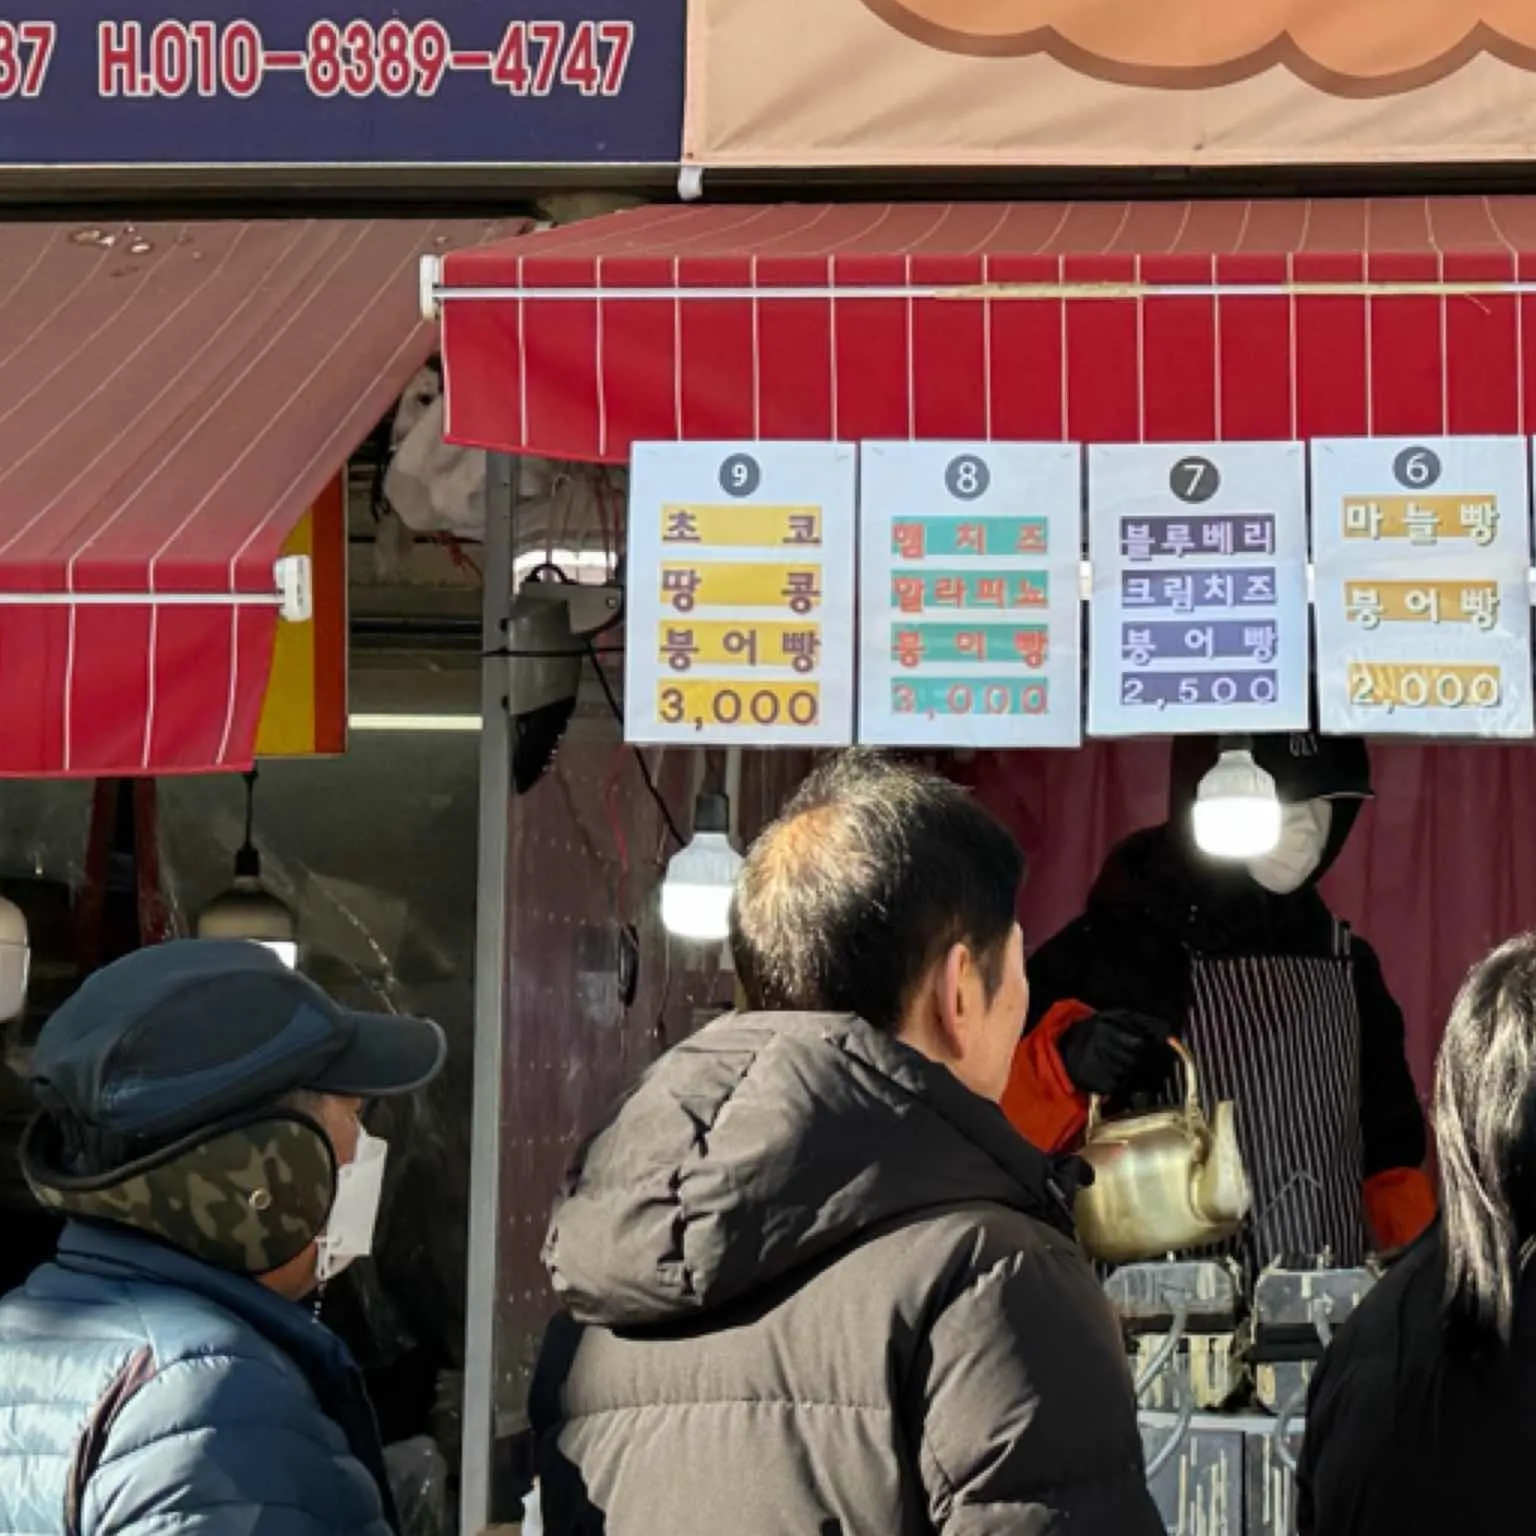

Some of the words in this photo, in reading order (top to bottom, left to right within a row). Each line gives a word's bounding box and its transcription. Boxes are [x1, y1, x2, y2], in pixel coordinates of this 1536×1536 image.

[99, 20, 634, 99] H.010-8389-4747
[1122, 521, 1273, 561] 블루베리
[1346, 502, 1500, 545] 마늘빵
[1122, 575, 1275, 614] 크림치즈
[1348, 588, 1500, 631] 붕어빵
[660, 629, 821, 673] 붕어빵
[1122, 627, 1278, 665] 붕어빵
[660, 688, 818, 731] 3,000
[892, 685, 1049, 721] 3,000
[1122, 677, 1276, 711] 2,500
[1351, 672, 1498, 714] 2,000
